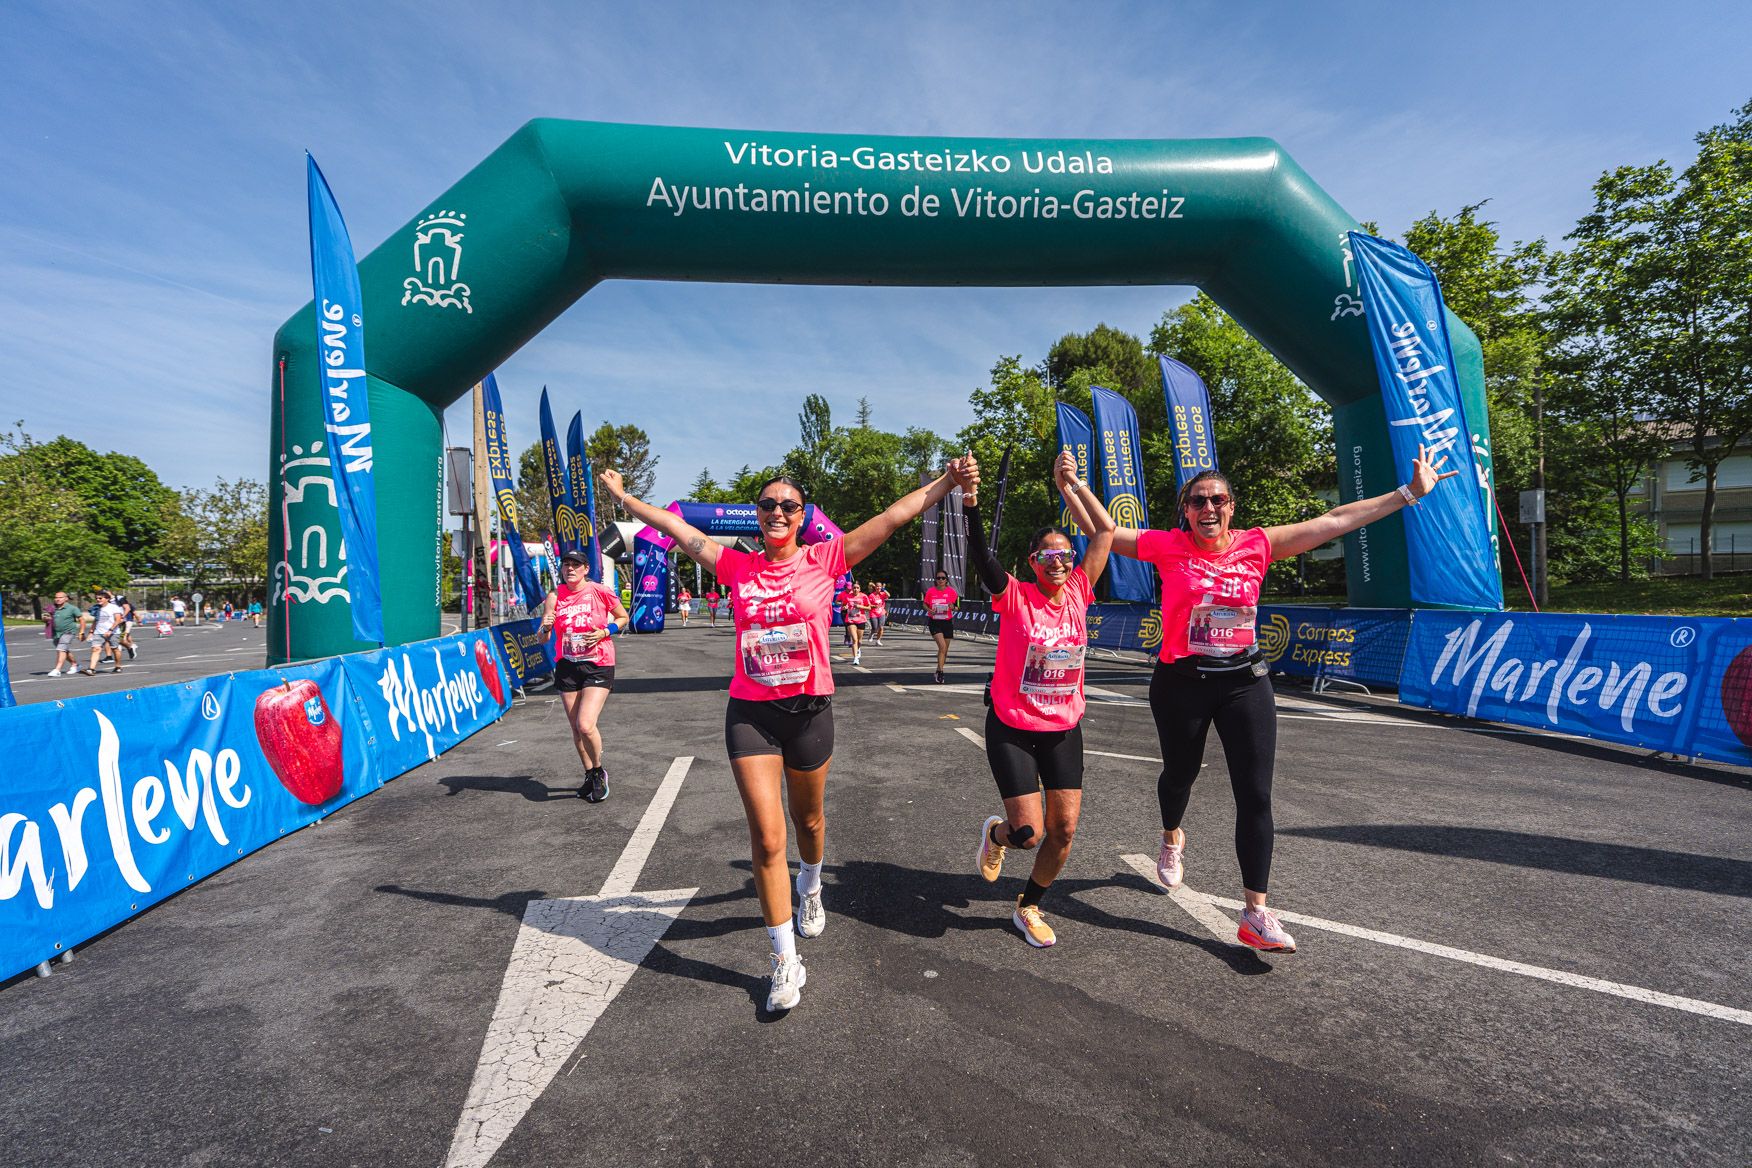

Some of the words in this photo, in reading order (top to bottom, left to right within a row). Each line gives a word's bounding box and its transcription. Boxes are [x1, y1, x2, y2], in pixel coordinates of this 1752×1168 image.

[724, 141, 1011, 173] Vitoria-Gasteizko
[1023, 151, 1114, 174] Udala
[646, 177, 889, 217] Ayuntamiento
[900, 185, 940, 218] de
[951, 188, 1185, 220] Vitoria-Gasteiz
[546, 439, 560, 497] Correos
[434, 456, 443, 607] www.vitoria-gasteiz.org
[1353, 445, 1371, 583] www.vitoasteiz.org
[1210, 628, 1234, 638] 016
[1297, 622, 1357, 643] Correos
[763, 653, 790, 665] 016
[1043, 669, 1066, 678] 016
[1292, 643, 1351, 667] Express
[1431, 619, 1688, 733] Marlene
[377, 645, 483, 759] Marlene
[0, 709, 251, 909] arlene
